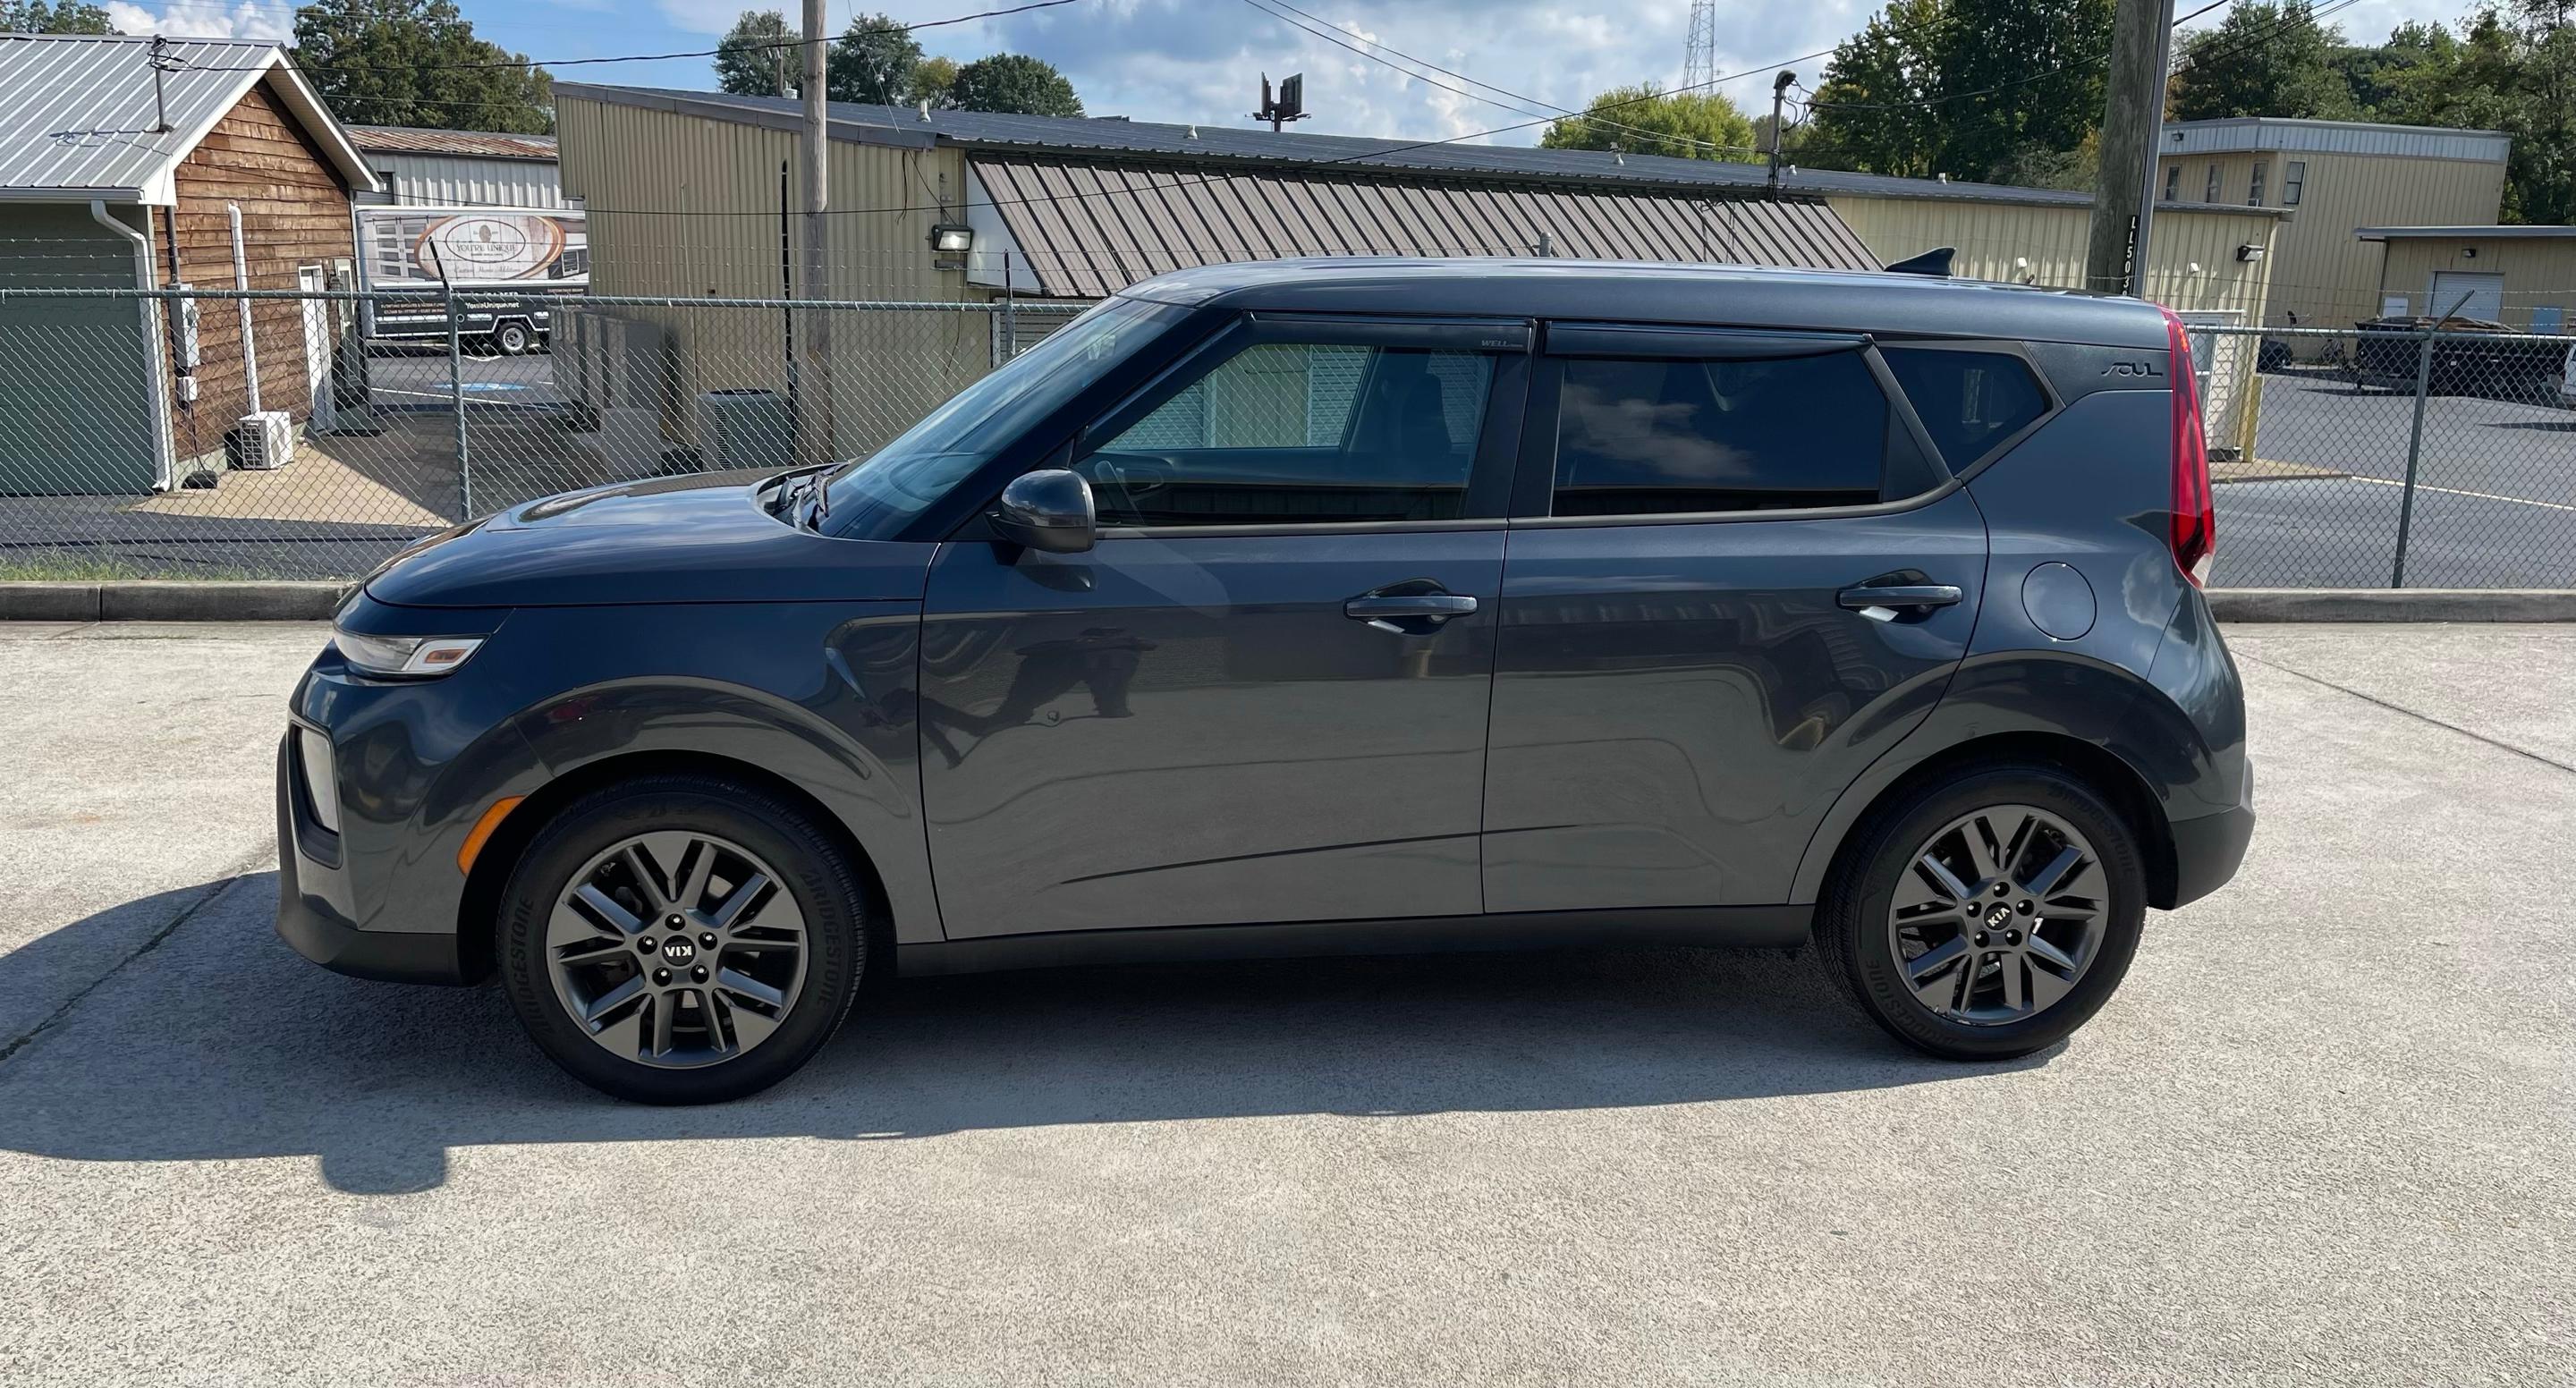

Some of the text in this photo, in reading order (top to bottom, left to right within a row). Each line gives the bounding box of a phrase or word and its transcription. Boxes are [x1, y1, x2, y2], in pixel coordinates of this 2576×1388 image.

[487, 243, 516, 253] UNIQUE
[2101, 362, 2163, 377] SOUL
[1987, 907, 2011, 927] KIA
[664, 944, 693, 958] KIA
